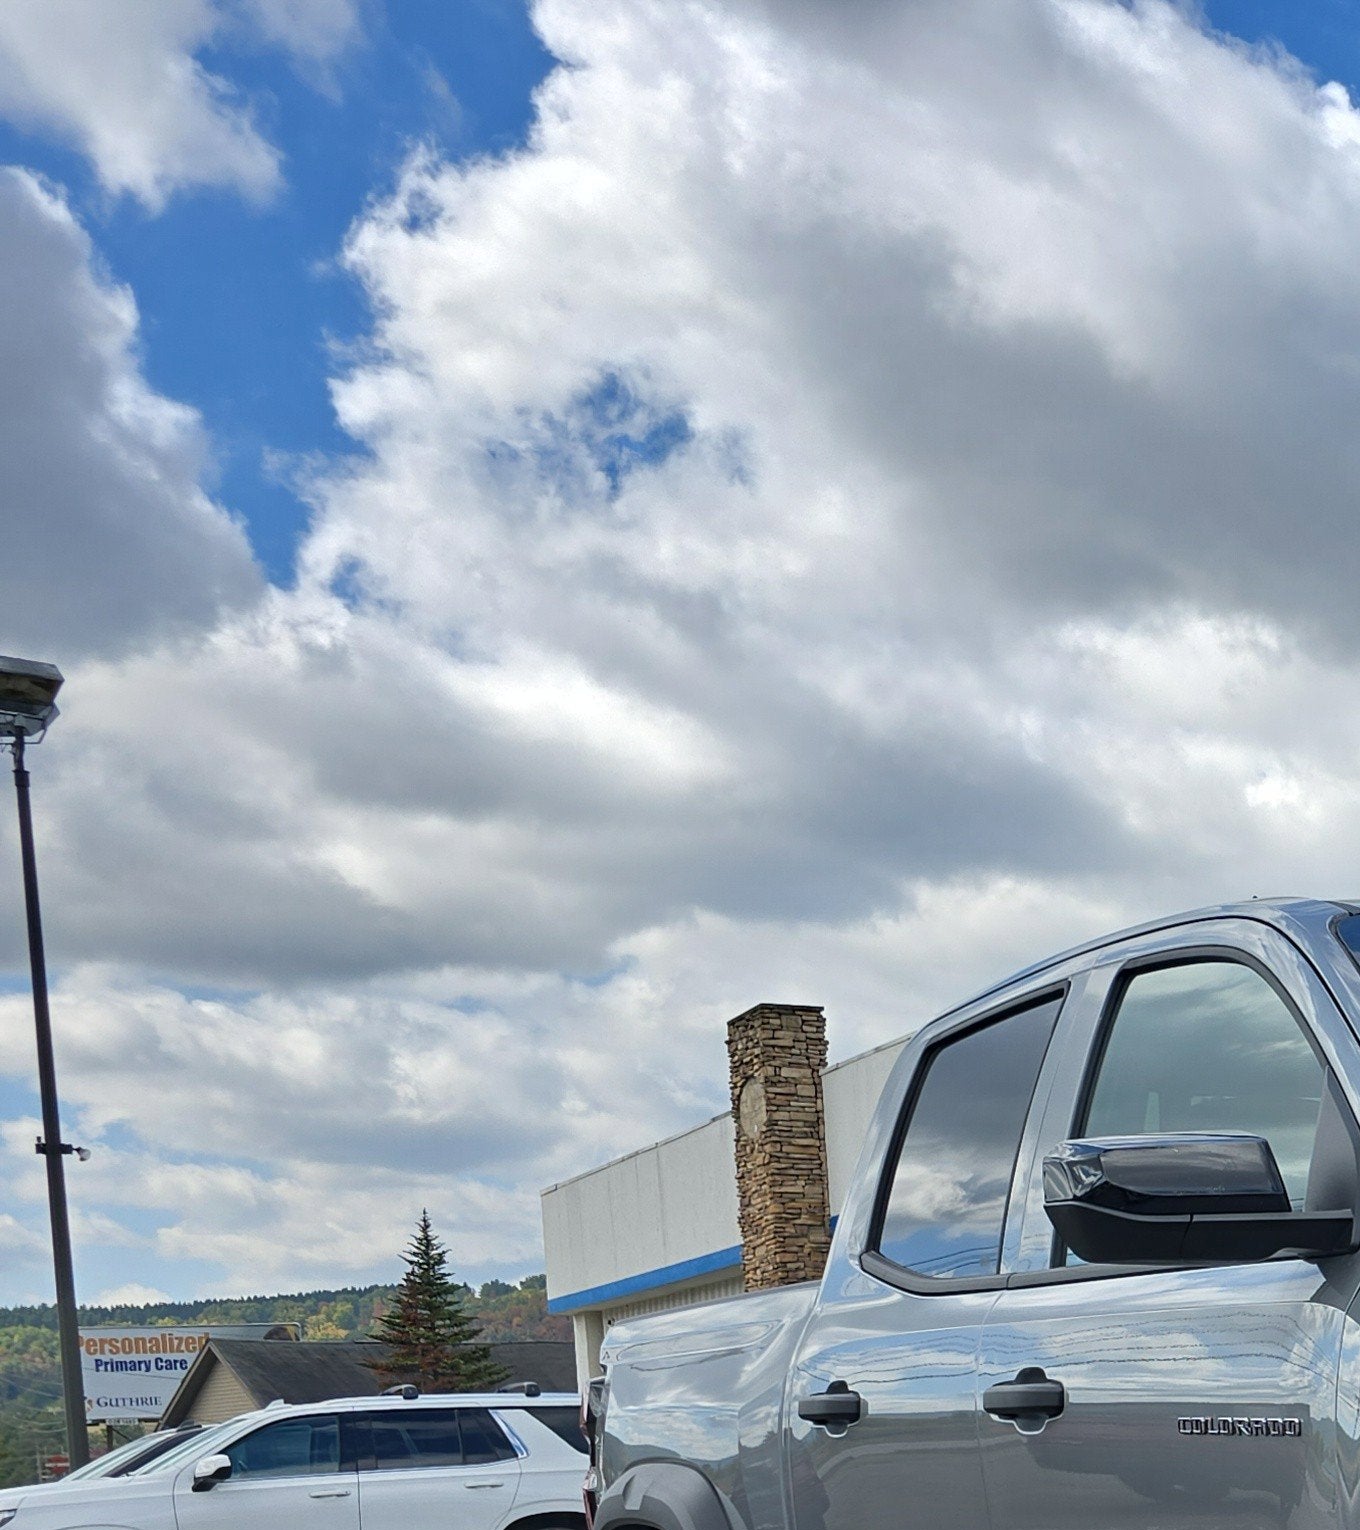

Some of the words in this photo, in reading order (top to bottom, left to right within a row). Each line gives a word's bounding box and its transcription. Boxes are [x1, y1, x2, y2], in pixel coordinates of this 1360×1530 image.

[94, 1358, 151, 1373] Primary
[155, 1357, 188, 1371] Care
[97, 1396, 162, 1408] GUTHRIE
[1177, 1416, 1302, 1436] COLORADO
